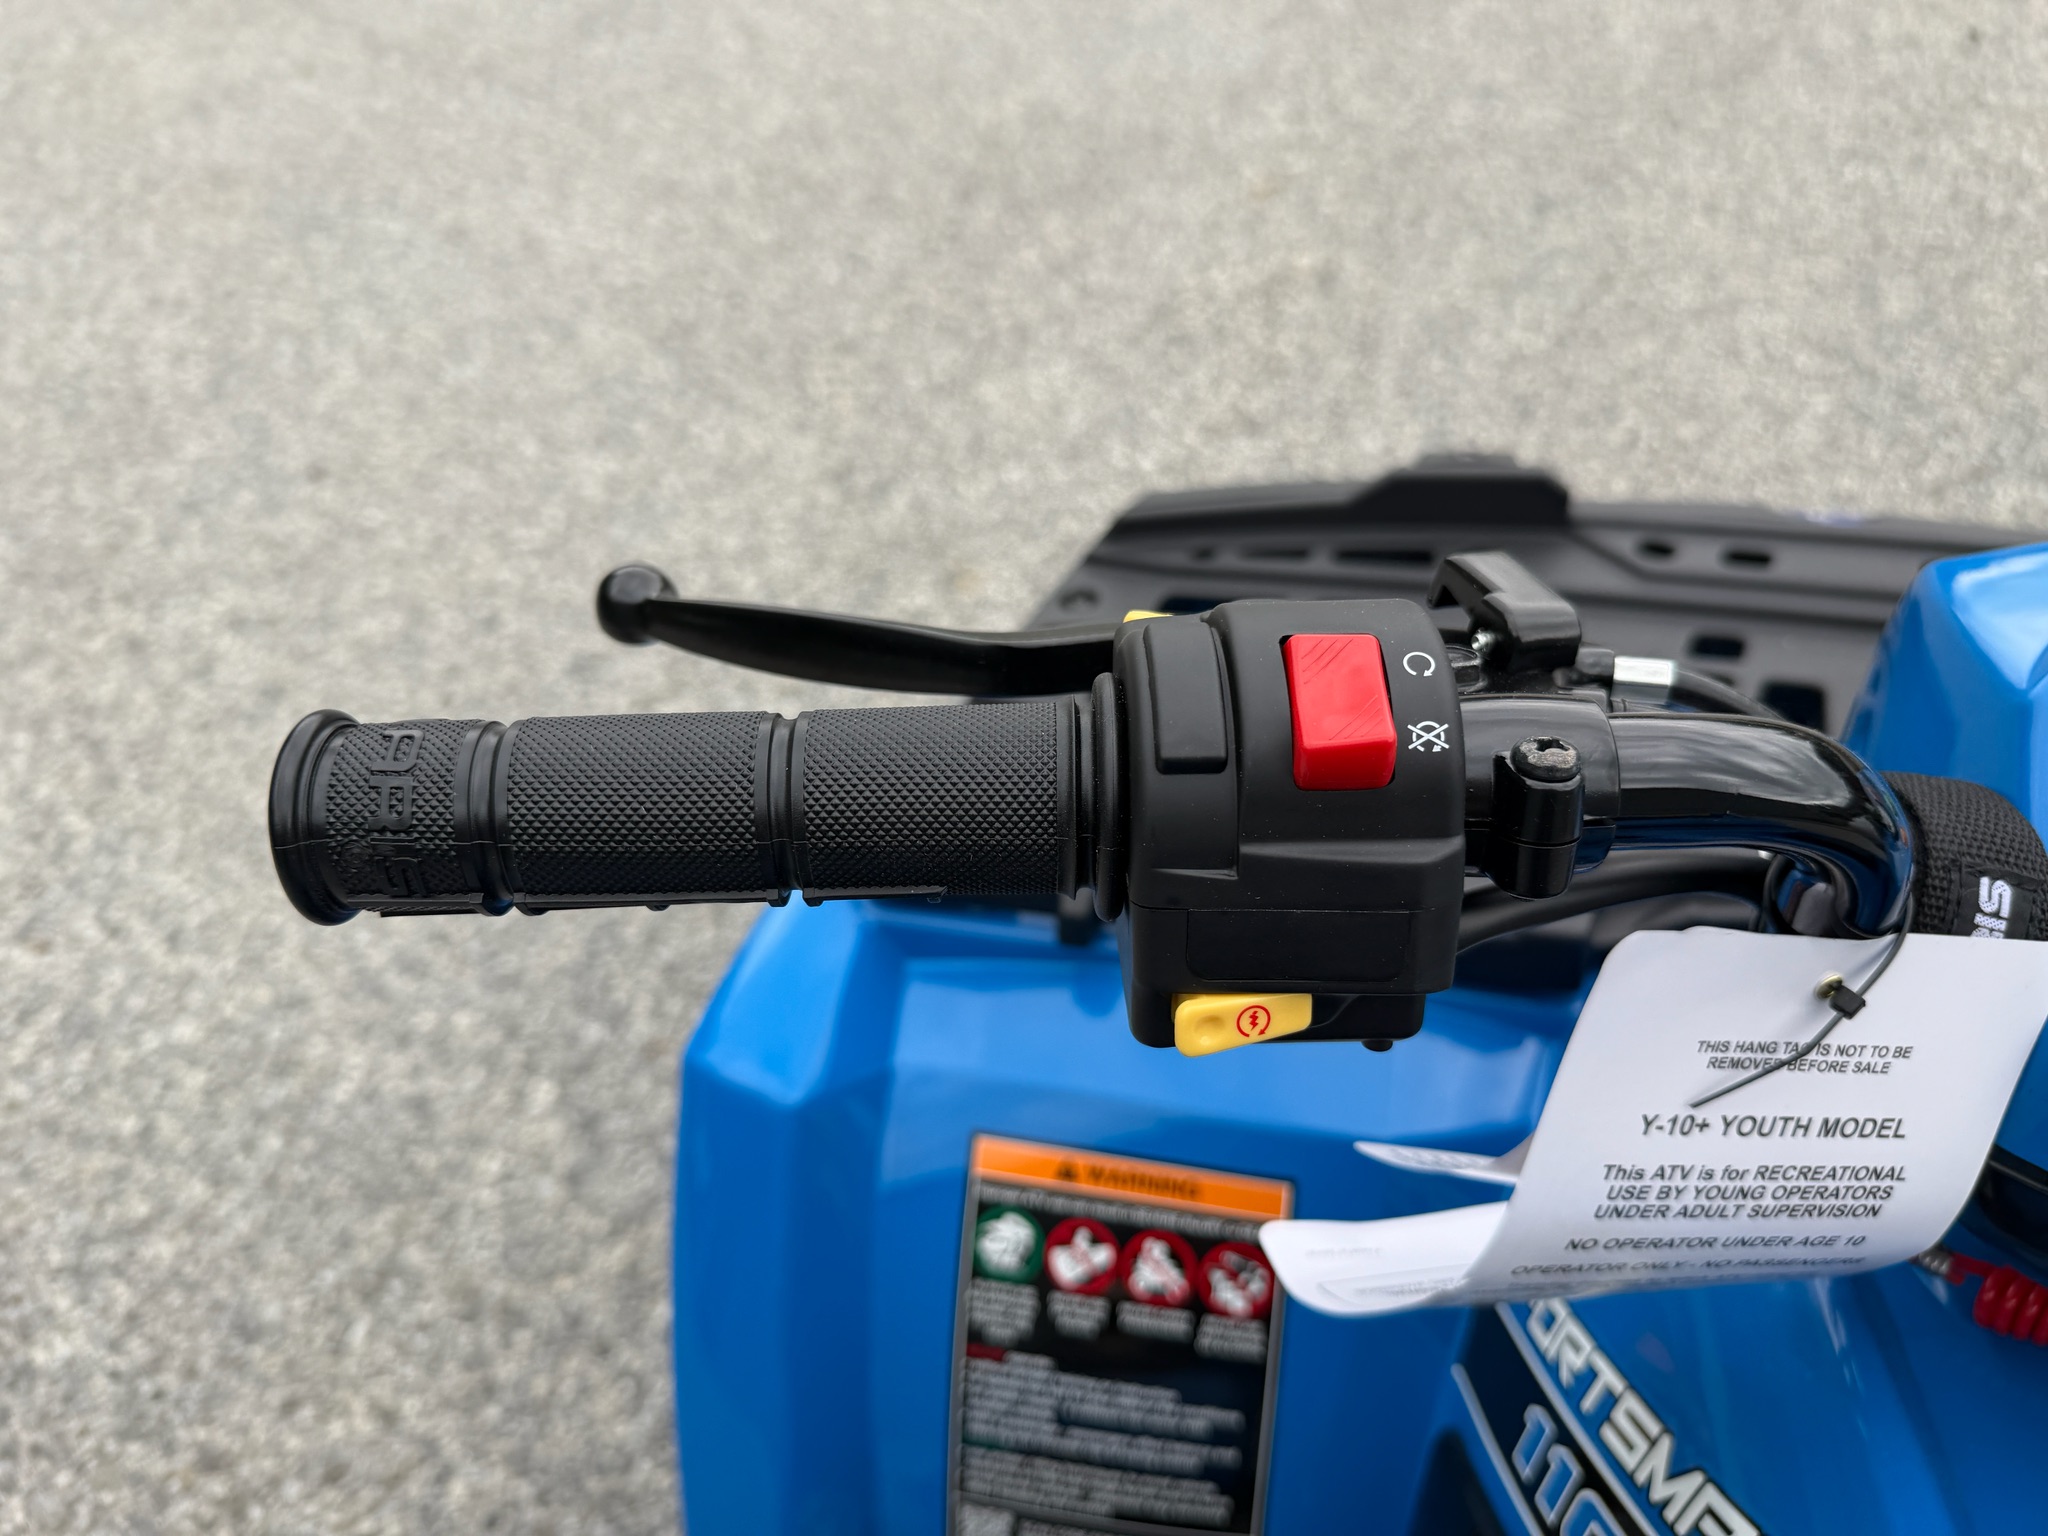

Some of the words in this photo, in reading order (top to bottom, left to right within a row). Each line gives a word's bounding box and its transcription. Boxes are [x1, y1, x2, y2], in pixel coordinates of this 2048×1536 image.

[1697, 1040, 1729, 1054] THIS
[1733, 1040, 1778, 1055] HANG
[1815, 1042, 1831, 1057] IS
[1834, 1043, 1867, 1058] NOT
[1869, 1045, 1890, 1059] TO
[1892, 1045, 1914, 1060] BE
[1786, 1058, 1850, 1074] BEFORE
[1851, 1060, 1892, 1075] SALE
[1641, 1113, 1710, 1137] Y-10+
[1720, 1114, 1813, 1138] YOUTH
[1816, 1116, 1907, 1139] MODEL
[1603, 1163, 1646, 1182] This
[1648, 1163, 1695, 1181] ATV
[1697, 1164, 1716, 1182] is
[1720, 1164, 1751, 1182] for
[1753, 1164, 1907, 1182] RECREATIONAL
[1606, 1184, 1652, 1201] USE
[1655, 1184, 1689, 1201] BY
[1692, 1184, 1767, 1201] YOUNG
[1770, 1184, 1894, 1201] OPERATORS
[1593, 1203, 1671, 1219] UNDER
[1673, 1203, 1746, 1219] ADULT
[1746, 1203, 1883, 1219] SUPERVISION
[1564, 1237, 1599, 1251] NO
[1601, 1236, 1718, 1250] OPERATOR
[1720, 1235, 1794, 1249] UNDER
[1792, 1234, 1841, 1248] AGE
[1843, 1234, 1868, 1247] 10
[1510, 1260, 1627, 1276] OPERATOR
